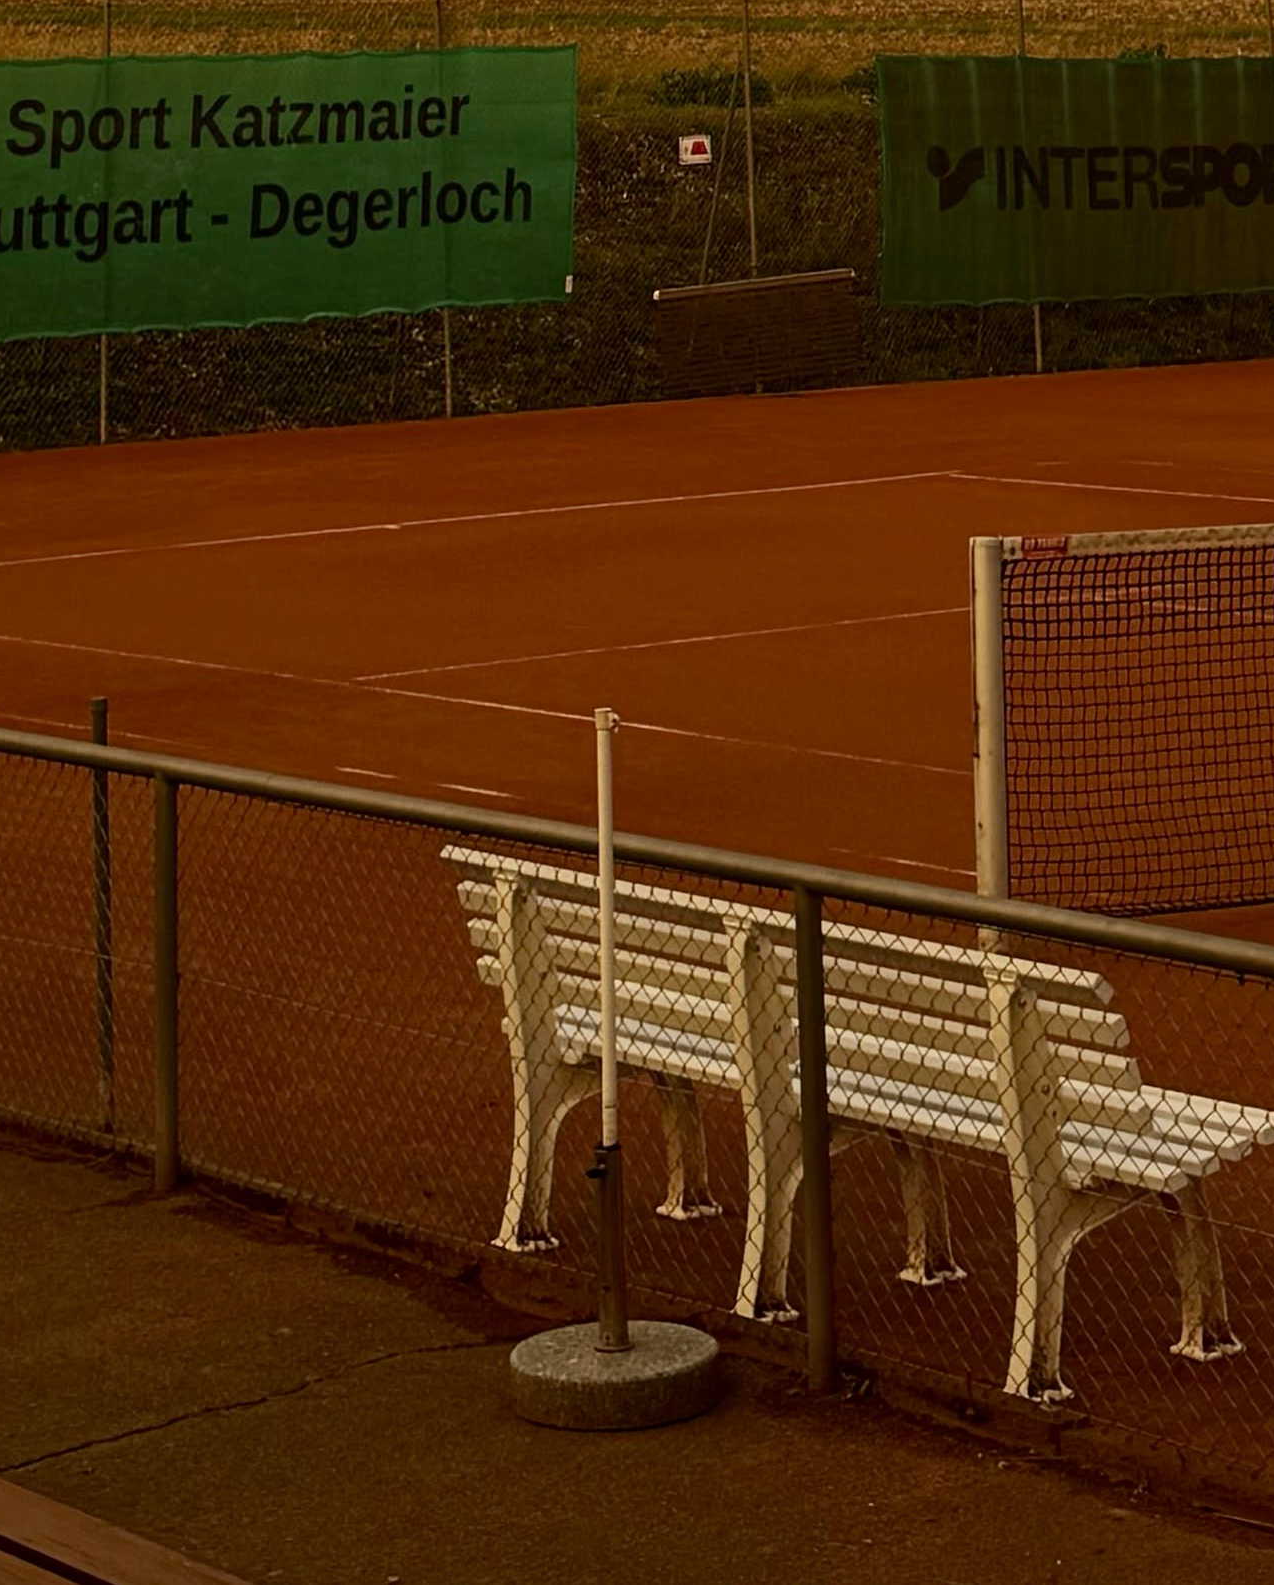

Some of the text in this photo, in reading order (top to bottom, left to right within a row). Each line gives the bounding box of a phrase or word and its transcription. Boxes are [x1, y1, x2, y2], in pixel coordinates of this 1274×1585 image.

[6, 85, 471, 169] Sport Katzmaier
[210, 214, 229, 226] -
[249, 166, 533, 249] Degerloch
